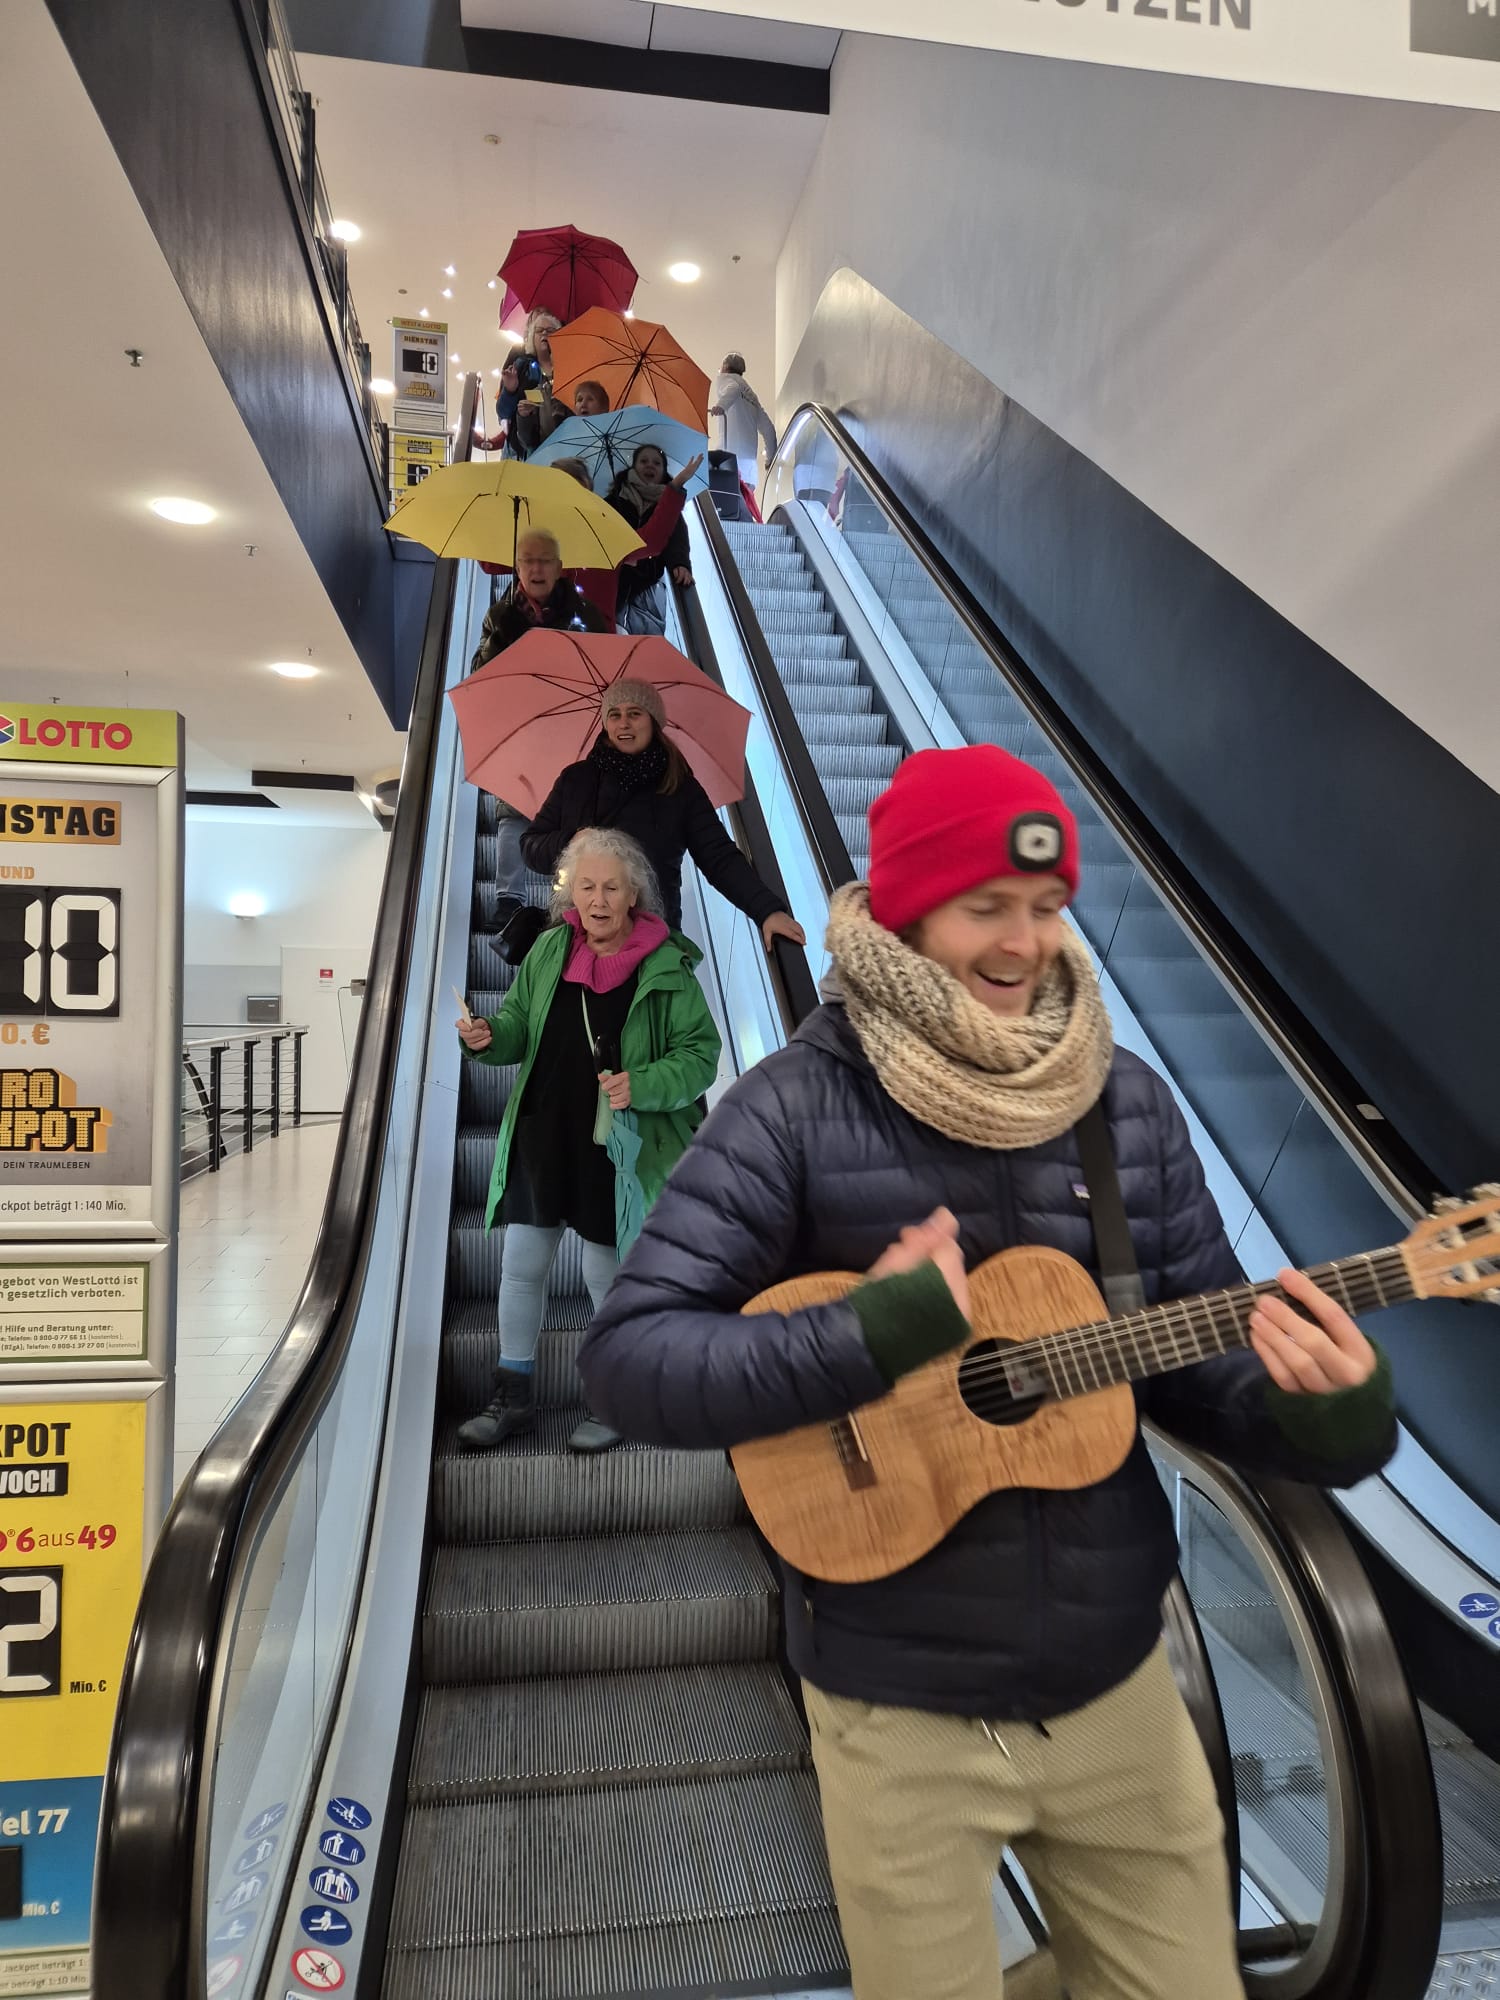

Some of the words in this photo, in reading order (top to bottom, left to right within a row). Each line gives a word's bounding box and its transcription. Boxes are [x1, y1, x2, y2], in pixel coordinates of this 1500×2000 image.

[422, 352, 438, 374] 10
[19, 717, 133, 750] LOTTO
[0, 803, 116, 837] STAG
[32, 1023, 50, 1046] €
[3, 1161, 25, 1169] DEIN
[29, 1161, 91, 1169] TRAUMLEBEN
[33, 1200, 72, 1213] beträgt
[105, 1200, 127, 1211] Mio.
[38, 1278, 60, 1286] von
[62, 1276, 121, 1286] WestLotto
[123, 1275, 139, 1285] ist
[7, 1289, 68, 1302] gesetzlich
[70, 1288, 126, 1298] verboten.
[5, 1325, 26, 1333] Hilfe
[46, 1324, 86, 1333] Beratung
[0, 1575, 58, 1692] 2
[70, 1681, 96, 1694] Mio.
[0, 1810, 31, 1836] el
[37, 1808, 70, 1834] 77
